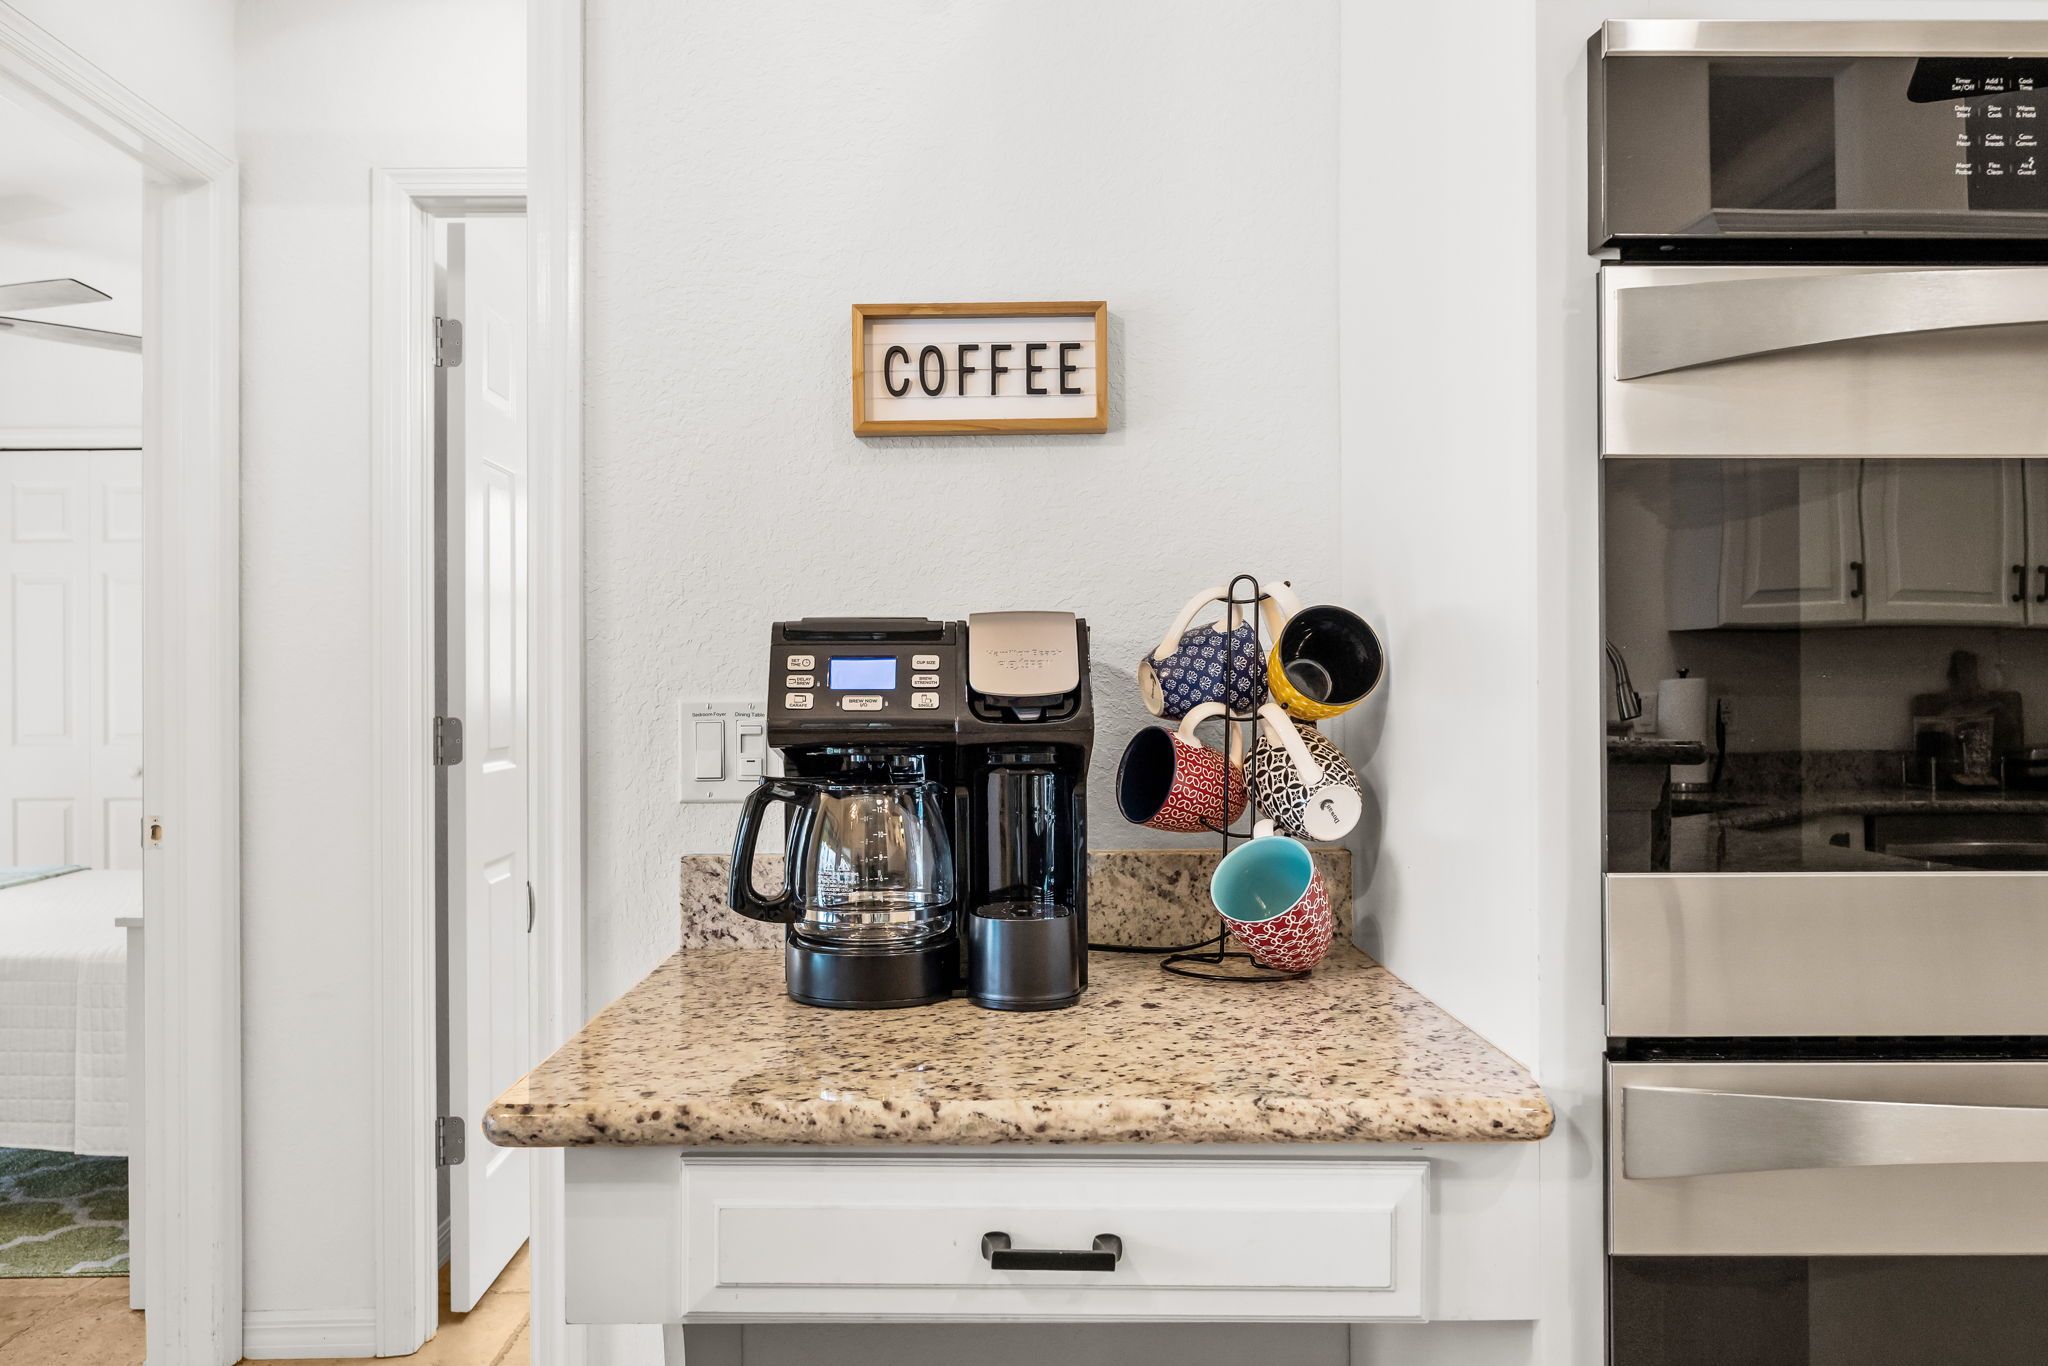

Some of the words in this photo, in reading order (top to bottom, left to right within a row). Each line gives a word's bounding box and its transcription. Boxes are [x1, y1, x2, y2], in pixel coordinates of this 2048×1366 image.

[1951, 84, 1975, 92] Set/Off
[1954, 105, 1972, 113] Delay
[884, 342, 1081, 397] COFFEE
